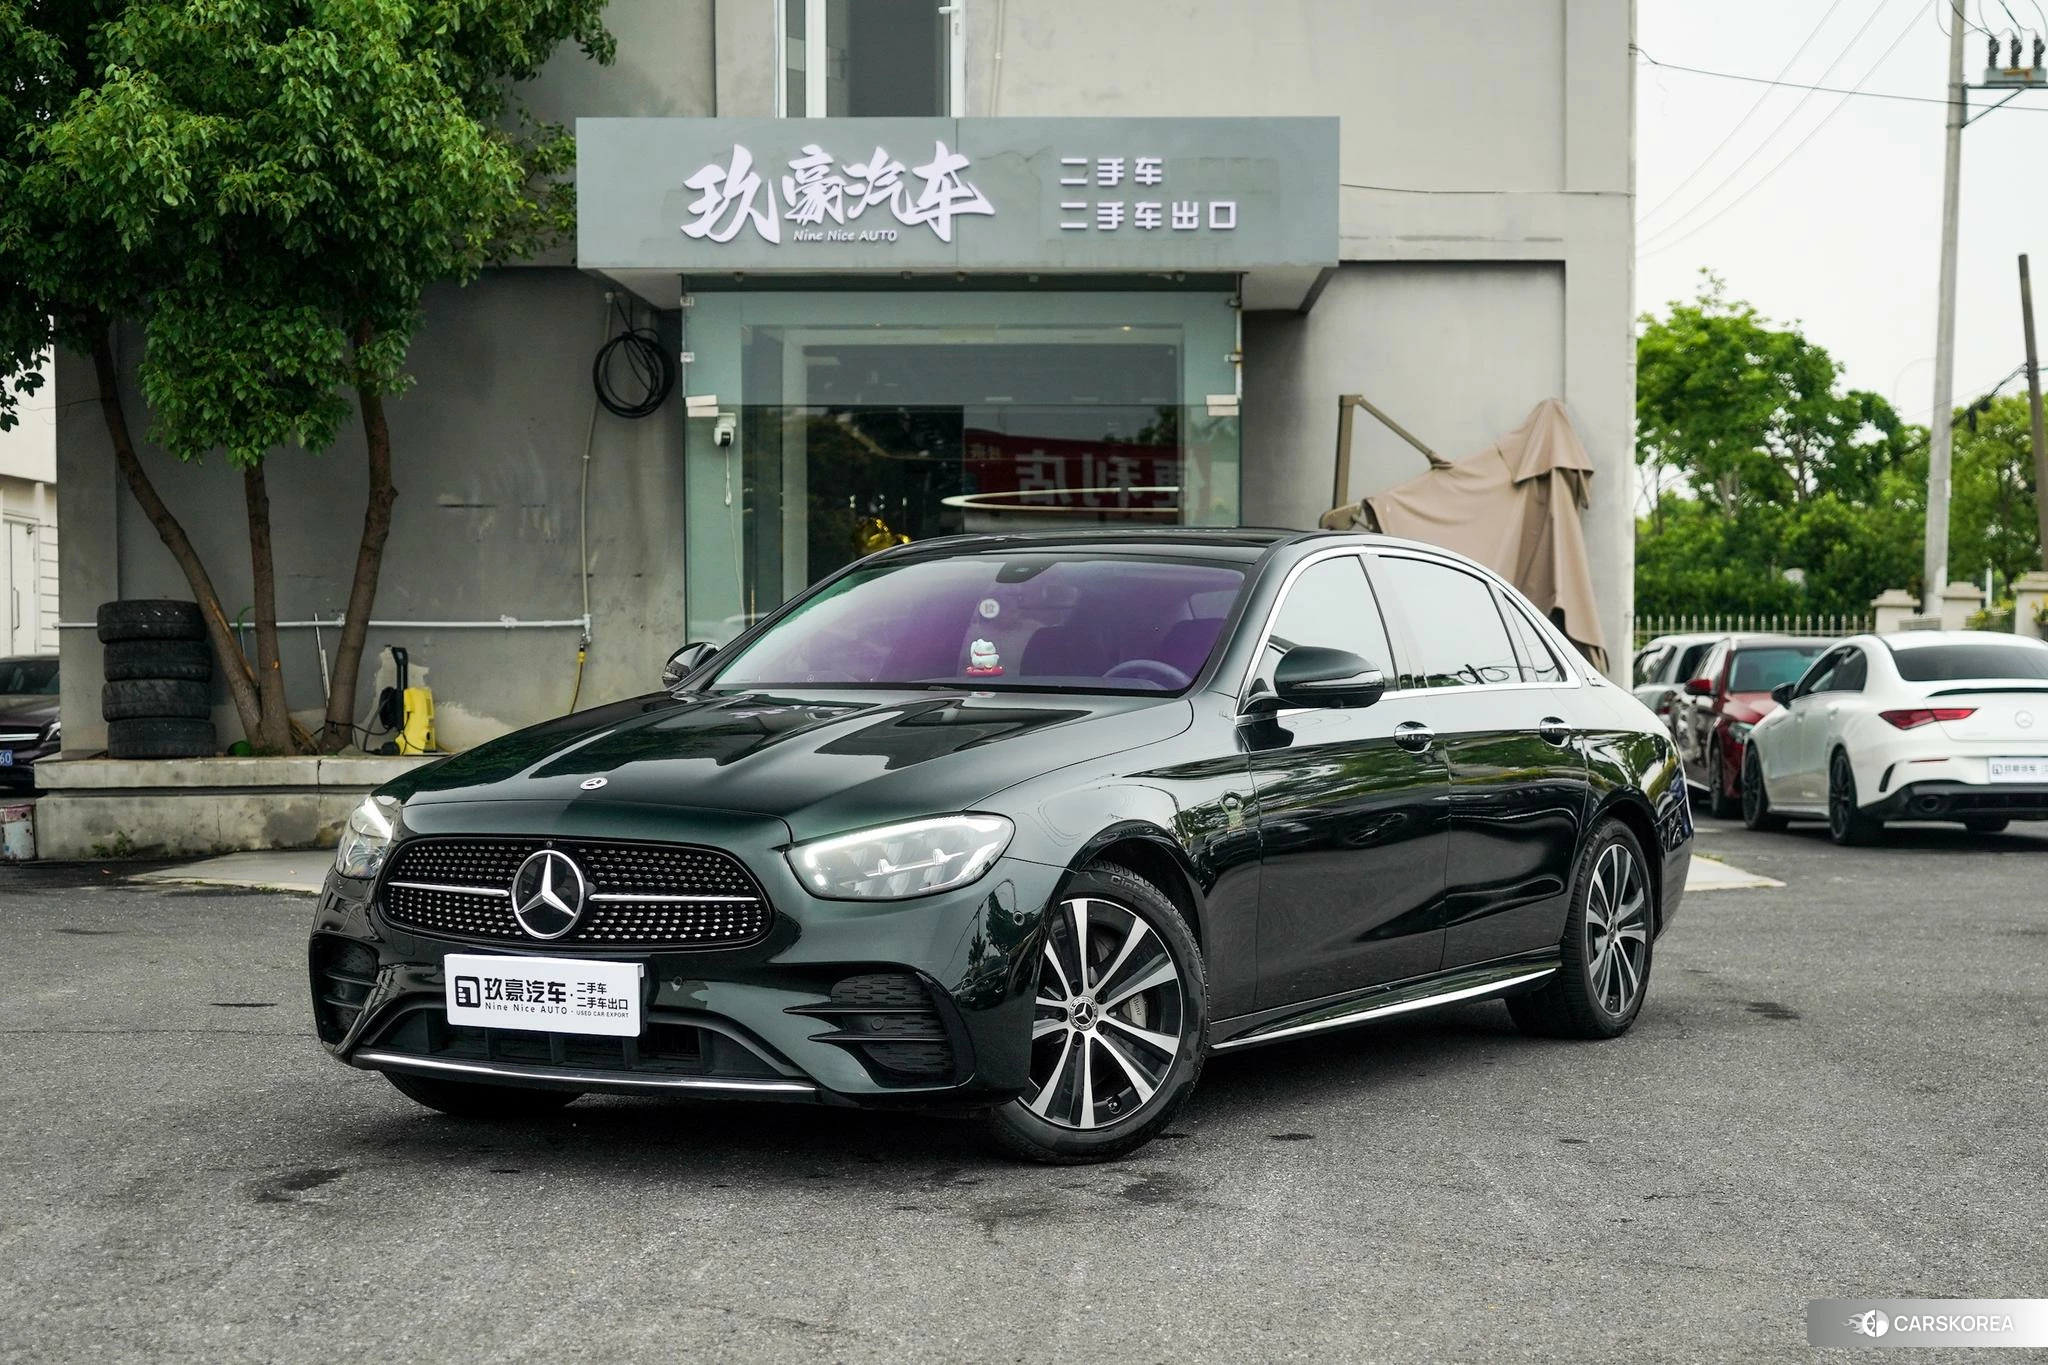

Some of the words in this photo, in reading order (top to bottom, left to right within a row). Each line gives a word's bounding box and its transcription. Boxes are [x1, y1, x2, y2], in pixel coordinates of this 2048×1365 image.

[1060, 157, 1162, 186] 二手车
[680, 140, 996, 244] 玖豪汽车
[1060, 200, 1236, 230] 二手车出口
[793, 229, 823, 241] Nine
[827, 229, 856, 241] Nice
[859, 230, 898, 242] AUTO
[484, 977, 567, 1004] 玖豪汽车
[577, 983, 607, 994] 二手车
[485, 1002, 508, 1011] Nine
[513, 1004, 536, 1013] Nice
[540, 1005, 568, 1015] AUTO
[577, 997, 628, 1010] 二手车出口
